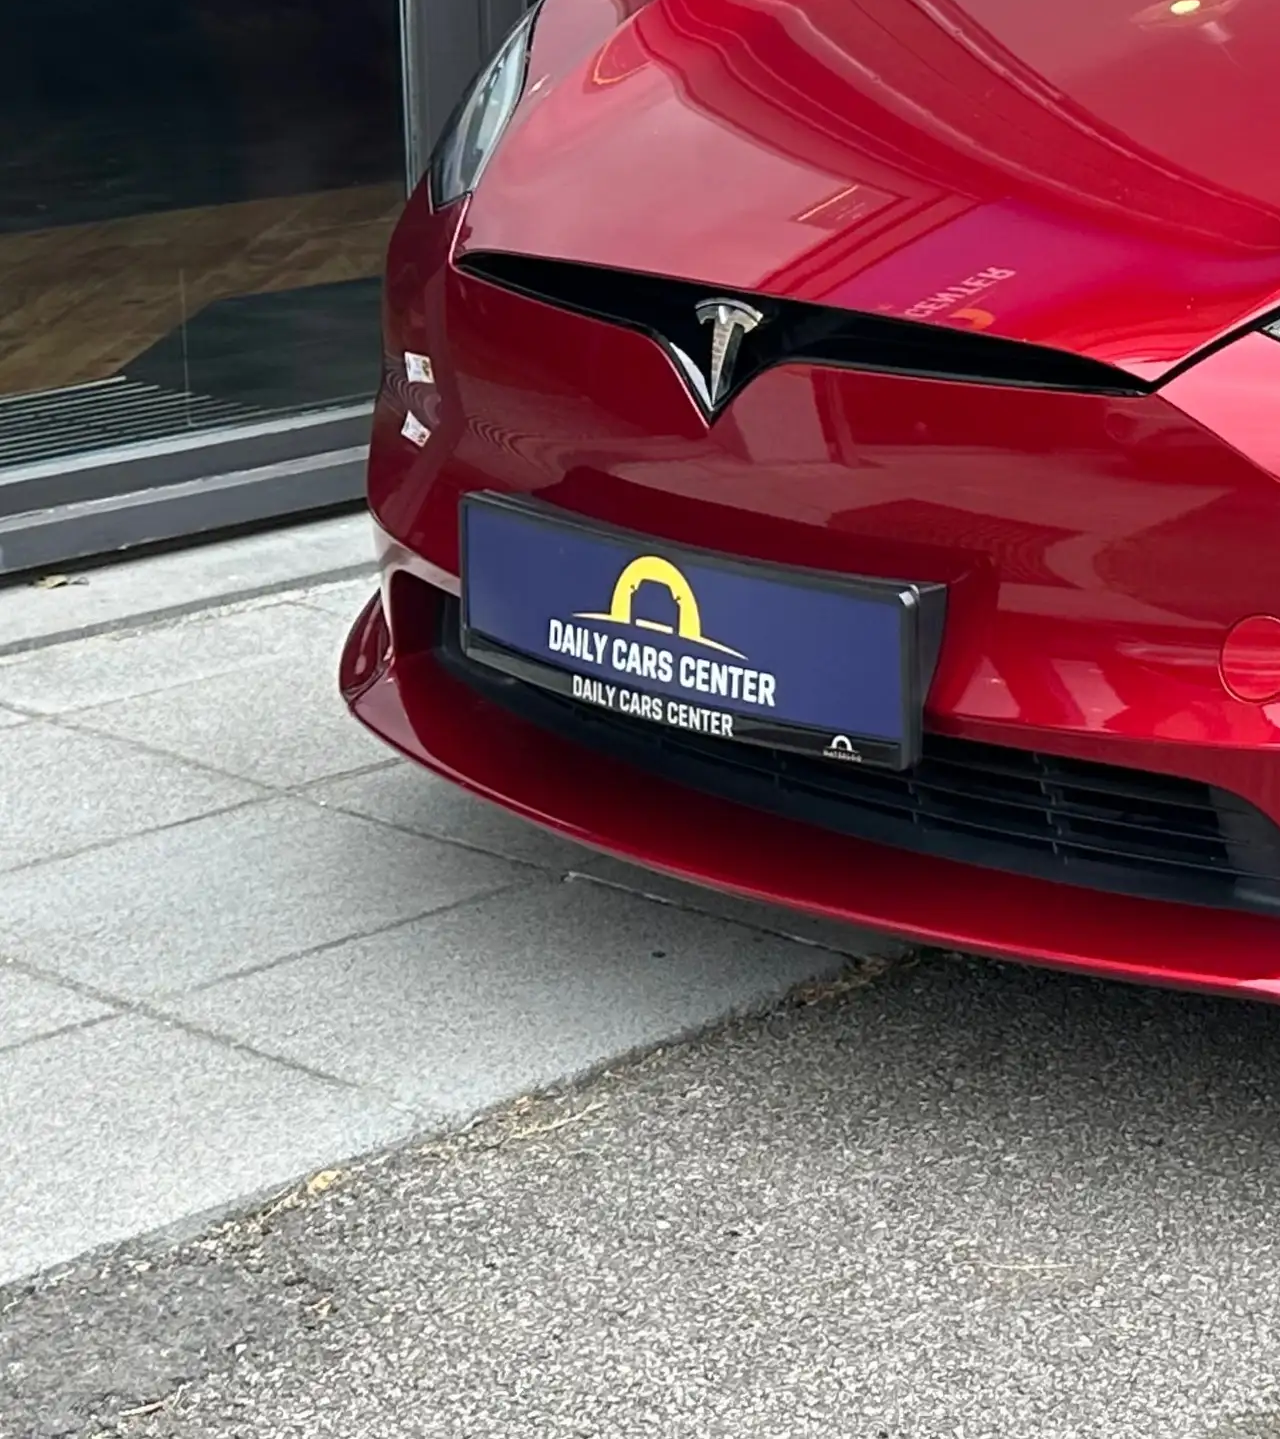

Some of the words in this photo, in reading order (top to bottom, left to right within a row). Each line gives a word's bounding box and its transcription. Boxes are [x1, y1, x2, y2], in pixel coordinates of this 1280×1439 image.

[549, 619, 608, 664] DAILY
[612, 639, 673, 682] CARS
[679, 656, 776, 707] CENTER
[573, 675, 616, 707] DAILY
[620, 690, 663, 720] CARS
[667, 701, 733, 737] CENTER
